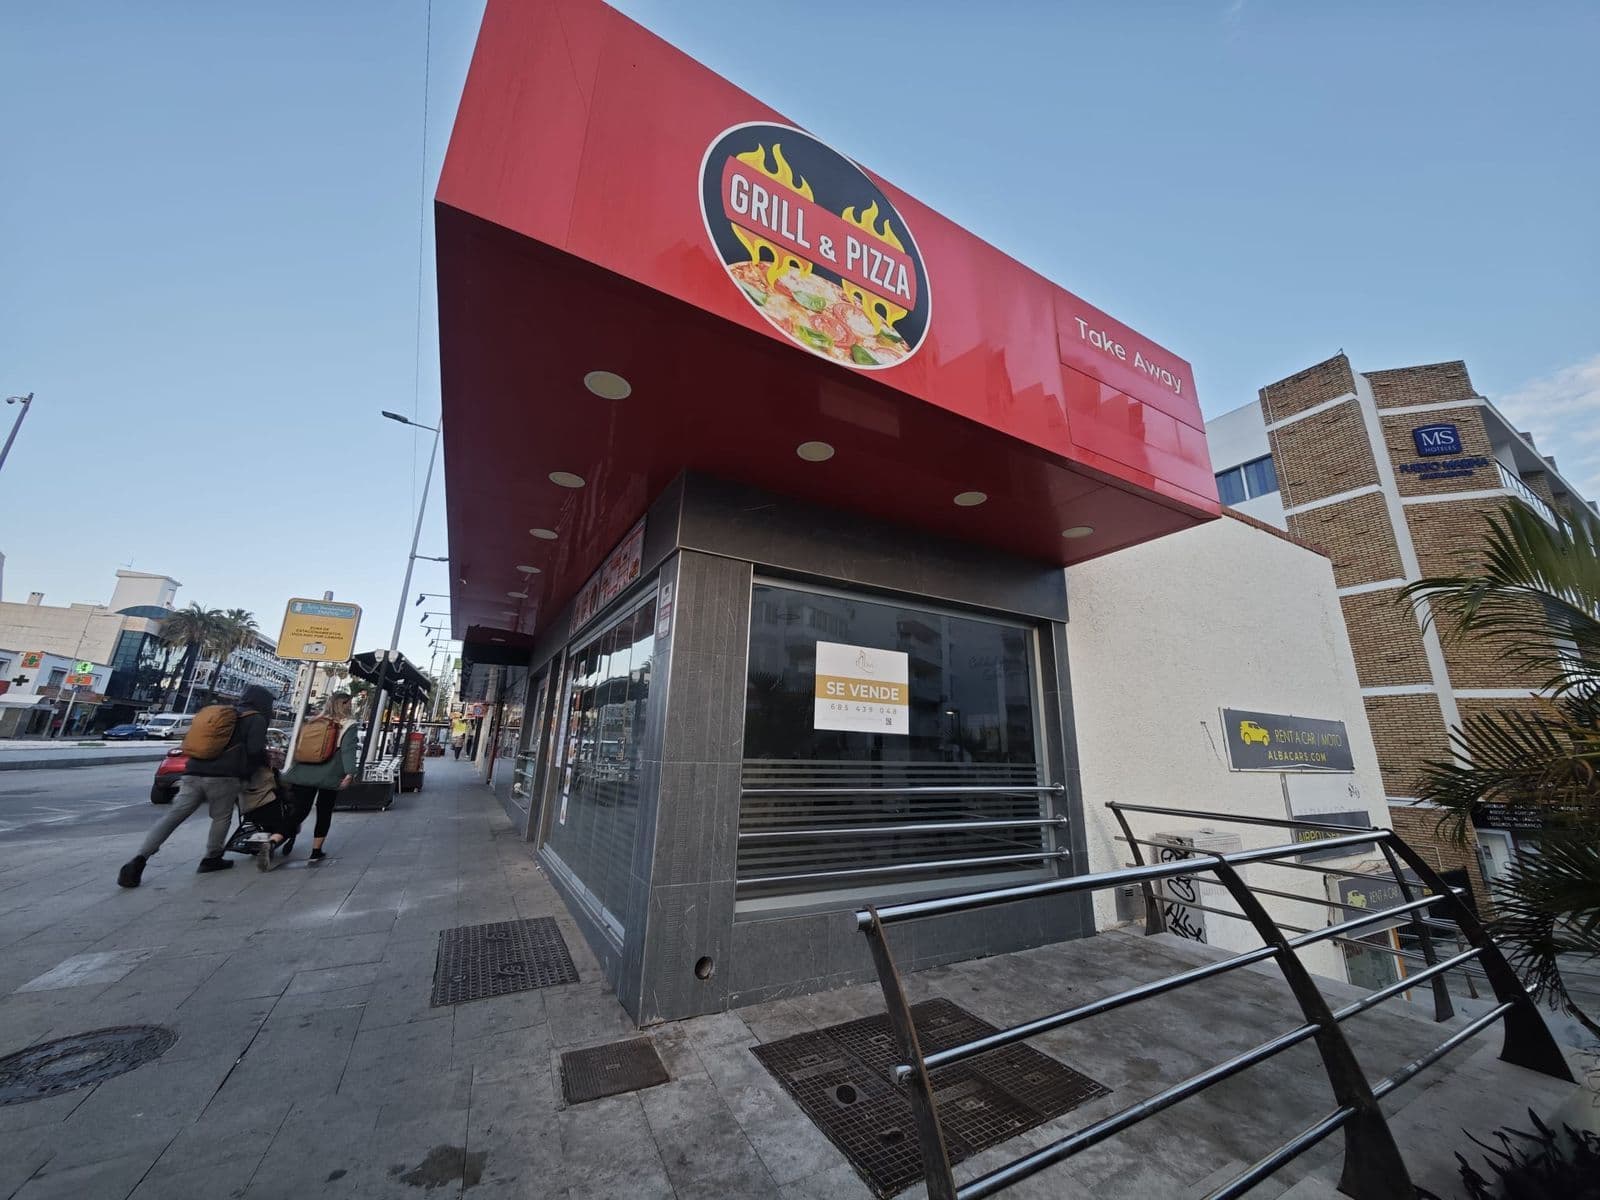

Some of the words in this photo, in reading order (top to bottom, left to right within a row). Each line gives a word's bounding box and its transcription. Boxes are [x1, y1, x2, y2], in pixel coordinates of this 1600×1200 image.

[730, 173, 811, 249] GRILL
[818, 234, 838, 263] &
[846, 235, 911, 300] PIZZA
[1074, 316, 1127, 361] Take
[1133, 351, 1182, 394] Away
[1421, 430, 1455, 446] MS
[1425, 445, 1457, 453] HOTELES
[826, 681, 846, 696] SE
[849, 683, 900, 701] VENDE
[1274, 729, 1294, 744] RENT
[1294, 731, 1301, 744] A
[1301, 731, 1316, 746] CAR
[1322, 734, 1343, 748] MOTO
[1268, 751, 1327, 762] ALBACARS.COM
